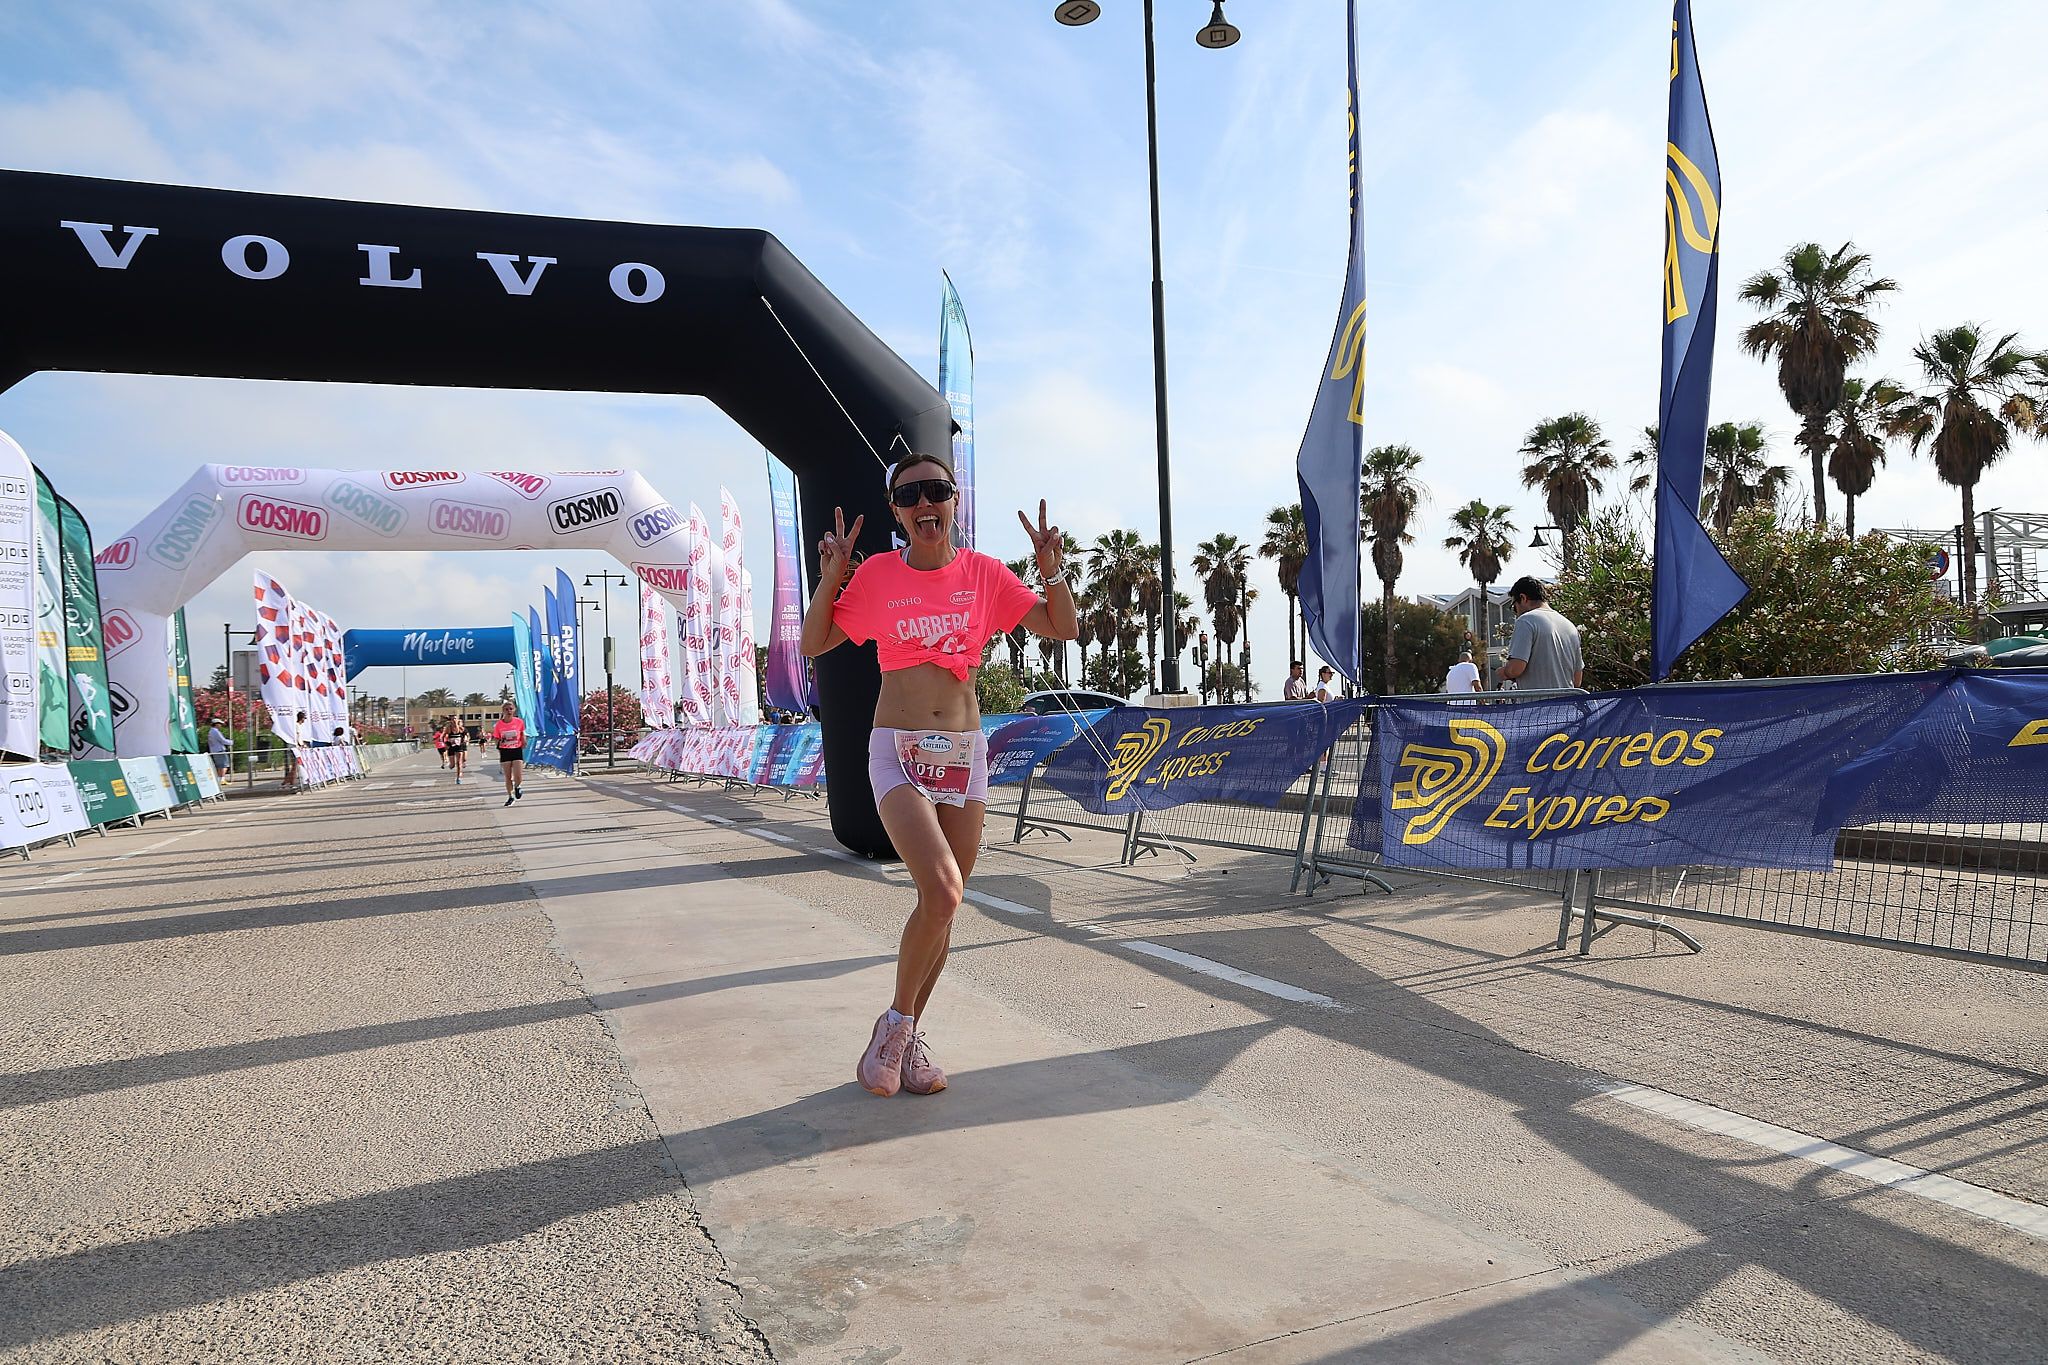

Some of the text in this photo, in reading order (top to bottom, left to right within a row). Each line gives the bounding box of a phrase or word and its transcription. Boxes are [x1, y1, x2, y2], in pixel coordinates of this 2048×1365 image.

[60, 219, 666, 304] VOLVO
[224, 466, 300, 482] COSMO
[245, 499, 322, 536] COSMO
[331, 483, 400, 533] COSMO
[435, 504, 504, 537] COSMO
[555, 491, 619, 529] COSMO
[155, 499, 215, 563] COSMO
[887, 596, 922, 609] OYSHO
[403, 631, 475, 661] Marlene
[1526, 728, 1724, 773] Correos
[916, 763, 946, 778] 016
